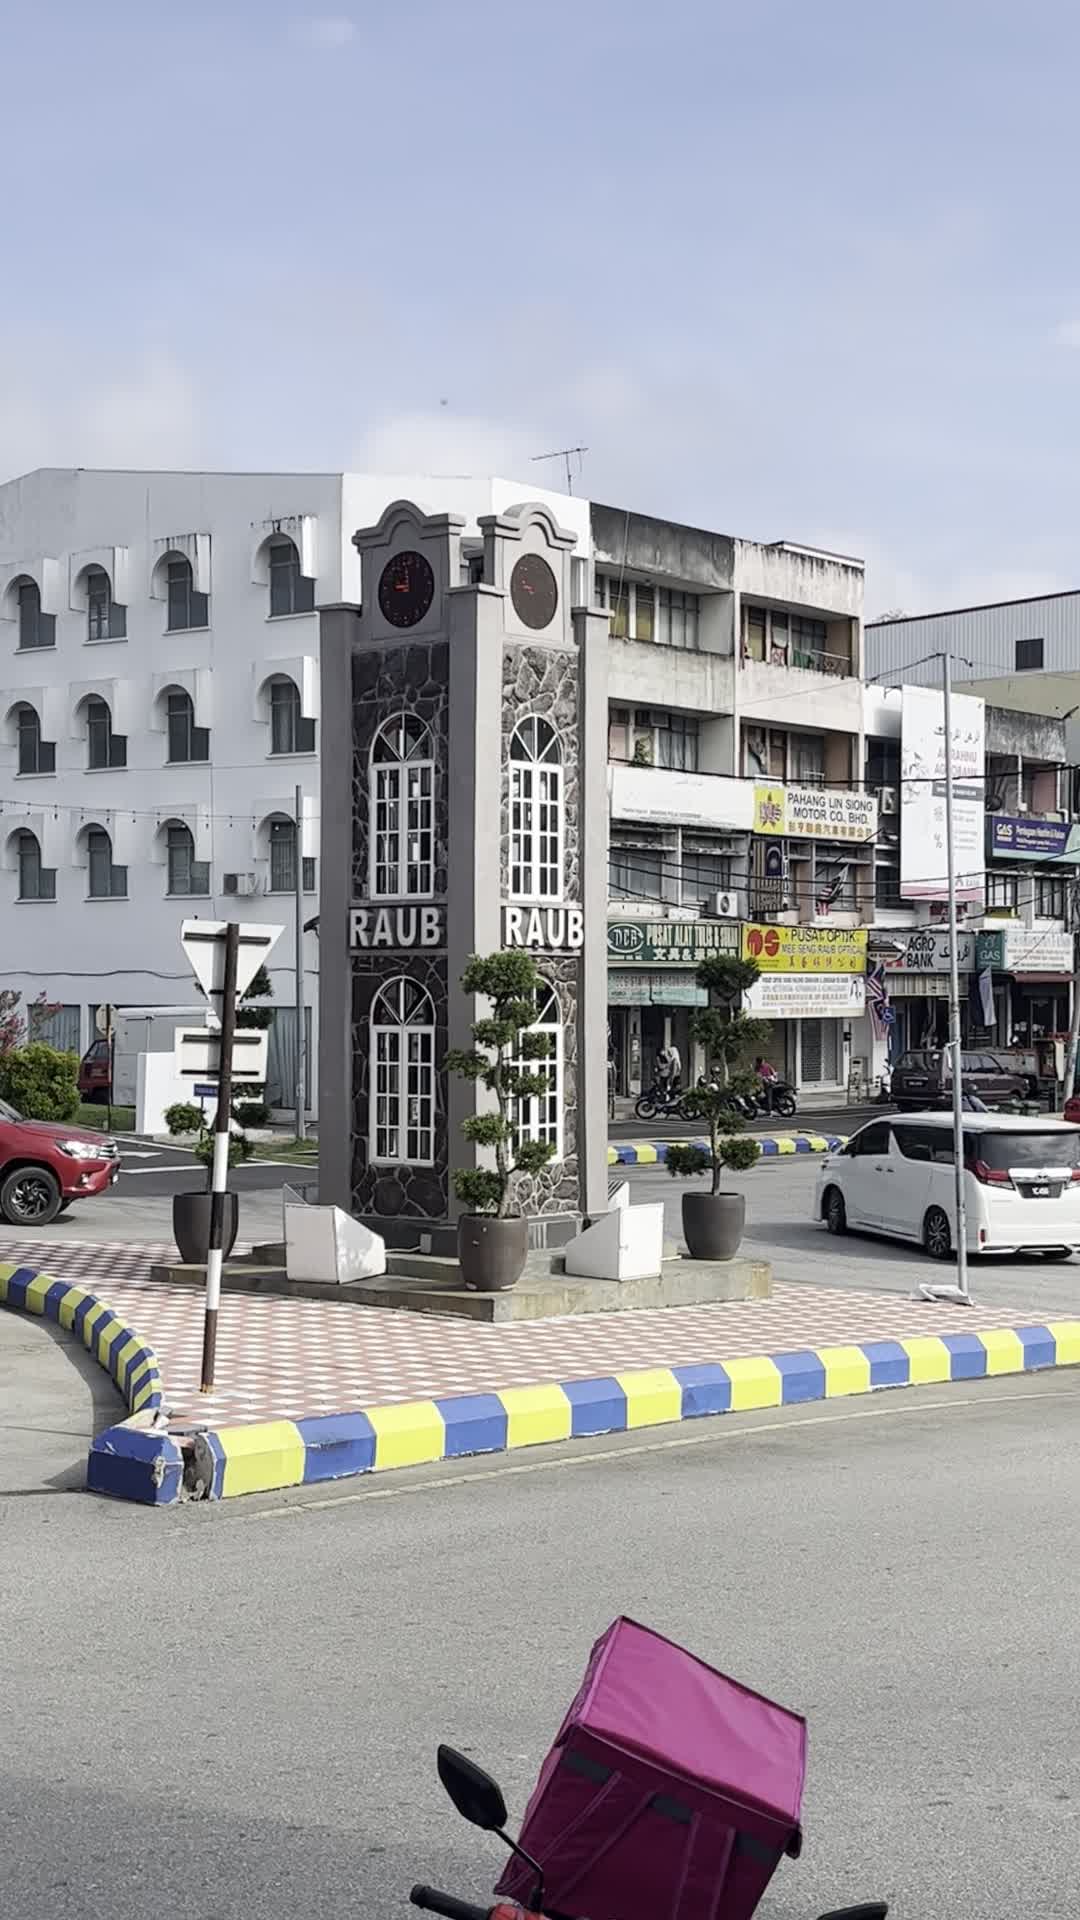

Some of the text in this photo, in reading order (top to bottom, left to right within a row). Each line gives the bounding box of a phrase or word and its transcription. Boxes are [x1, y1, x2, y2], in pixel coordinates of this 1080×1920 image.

[934, 762, 977, 777] AGOBANK
[787, 793, 873, 812] PAHANG LIN SIONG
[793, 807, 827, 820] MOTOR
[350, 907, 440, 947] RAUB
[505, 906, 584, 947] RAUB
[646, 925, 673, 946] PUSAT
[674, 925, 693, 946] ALAT
[827, 930, 856, 943] OPTIK
[907, 936, 936, 952] AGRO
[906, 952, 934, 968] BANK
[980, 950, 1001, 960] GAS
